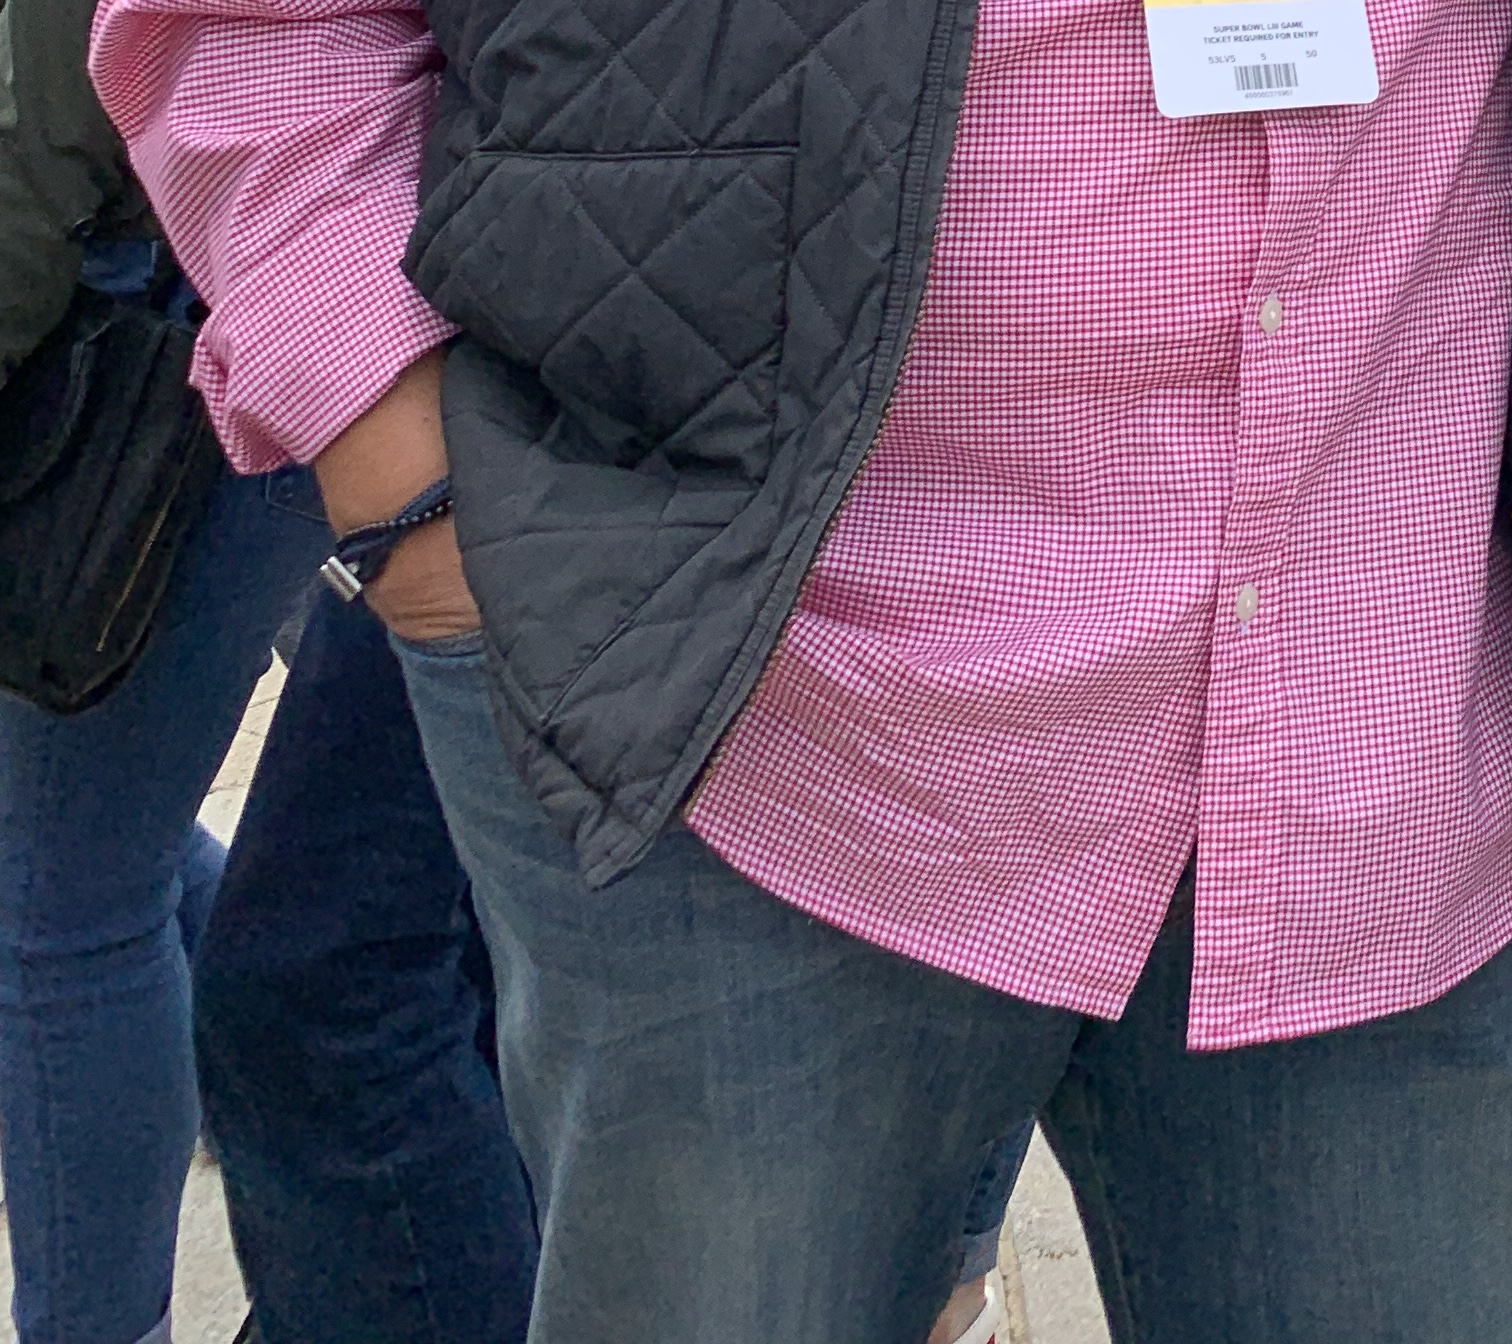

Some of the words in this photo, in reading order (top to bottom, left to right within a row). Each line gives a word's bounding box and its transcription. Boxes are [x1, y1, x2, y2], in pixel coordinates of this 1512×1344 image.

[1213, 24, 1241, 34] SUPER
[1241, 23, 1266, 32] BOWL
[1280, 20, 1304, 30] GAME
[1203, 35, 1232, 45] TICKET
[1233, 33, 1274, 43] REQUIRED
[1275, 32, 1292, 41] FOR
[1292, 30, 1319, 40] ENTRY
